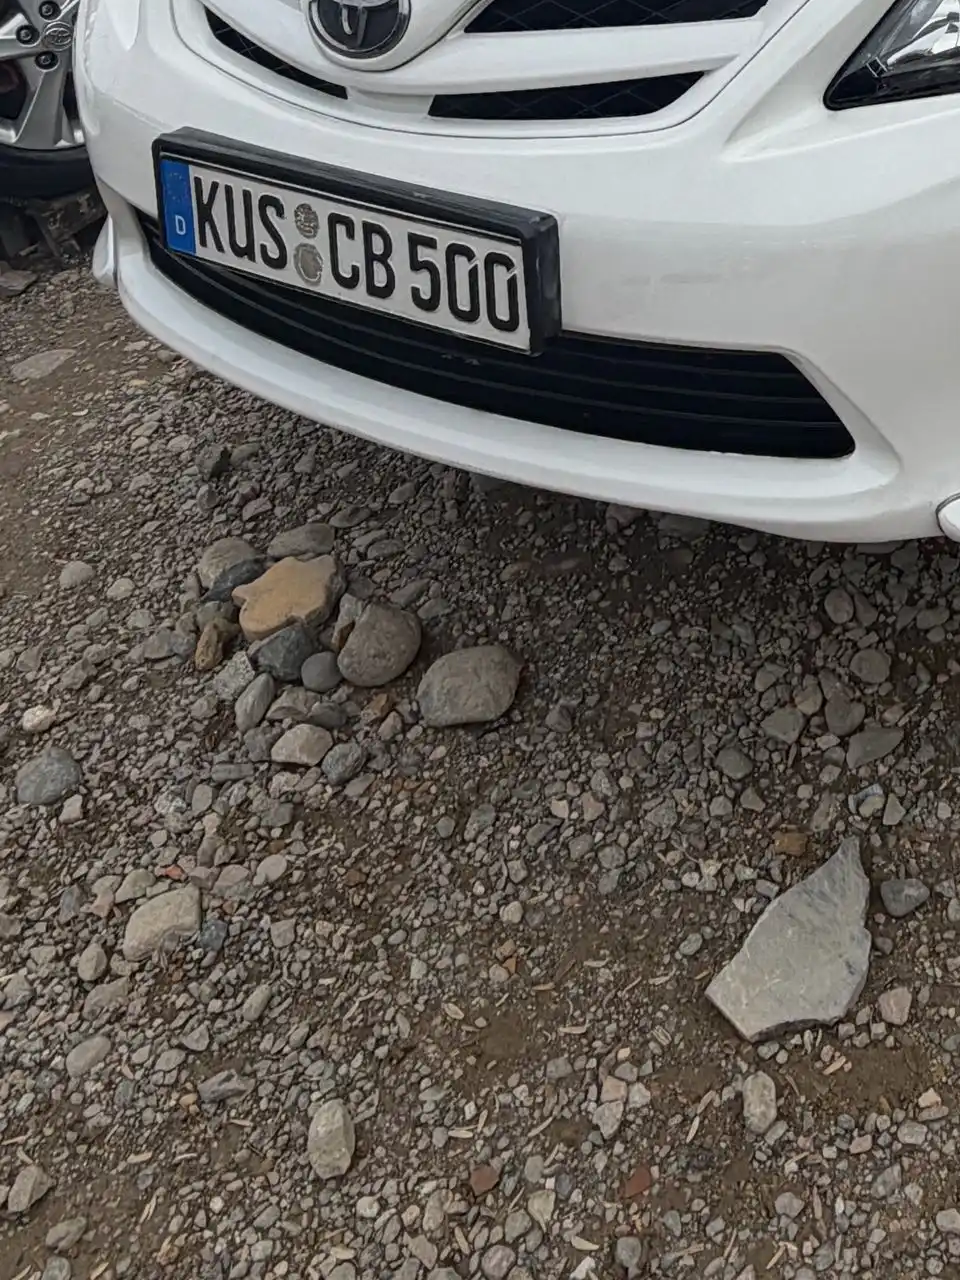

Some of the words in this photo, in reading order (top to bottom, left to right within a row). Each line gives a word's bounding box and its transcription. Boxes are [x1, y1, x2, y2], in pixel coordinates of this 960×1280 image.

[174, 213, 187, 236] D
[193, 175, 288, 270] KUS
[327, 210, 396, 300] CB
[406, 230, 520, 333] 500
